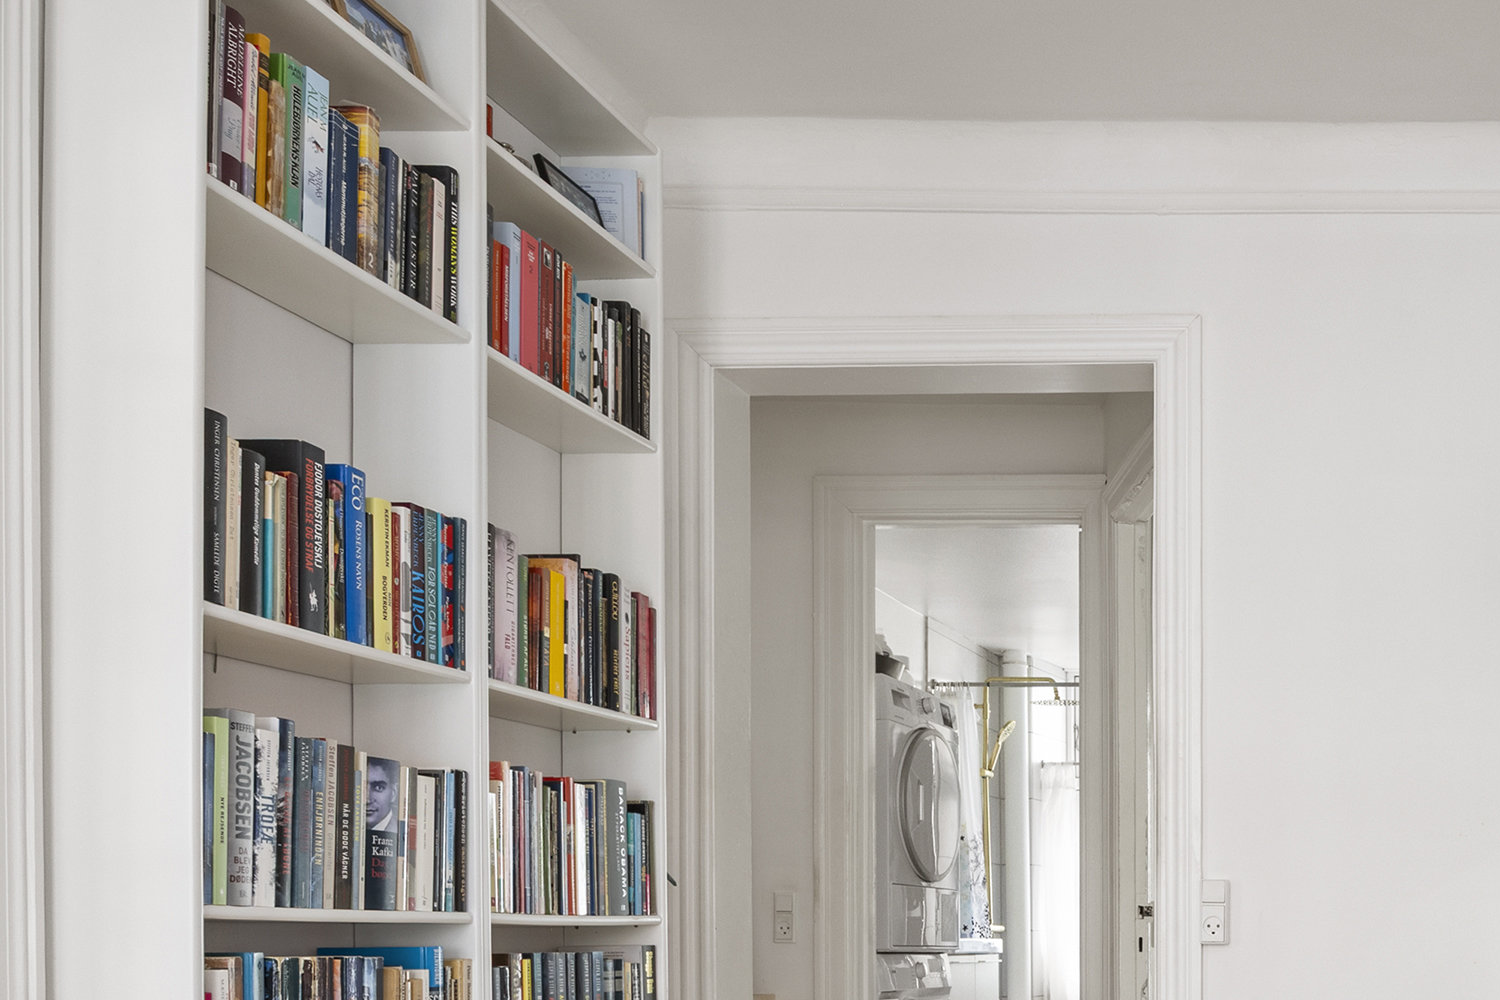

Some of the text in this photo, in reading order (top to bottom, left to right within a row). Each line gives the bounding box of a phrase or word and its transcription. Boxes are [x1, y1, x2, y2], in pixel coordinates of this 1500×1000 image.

[227, 22, 238, 88] ALBRIGHT
[236, 25, 245, 97] MADELEINE
[307, 83, 319, 123] AUEL
[320, 93, 328, 119] JEAN
[291, 161, 301, 188] KLAN
[450, 201, 458, 225] THIS
[368, 252, 374, 269] 2
[450, 226, 458, 274] WOMAN'S
[450, 276, 458, 308] WORK
[352, 472, 364, 510] ECO
[252, 487, 260, 536] Guddommelige
[305, 458, 314, 573] FORBRYDELSE OG STRAF
[314, 462, 323, 568] FJODOR DOSTOJEVSKIJ
[428, 567, 436, 586] FØR
[506, 538, 514, 617] KEN FOLLETT
[412, 570, 425, 645] KAIROS
[428, 610, 436, 631] GÅR
[235, 734, 252, 840] JACOBSEN
[260, 795, 275, 845] TROFÆ
[314, 791, 324, 865] ENHJØRNINGEN
[342, 802, 350, 818] NÅR
[342, 819, 348, 828] DE
[372, 835, 394, 846] Franz
[372, 846, 394, 856] Kafka
[618, 786, 628, 898] BARACK OBAMA
[342, 852, 350, 880] VÅGNER
